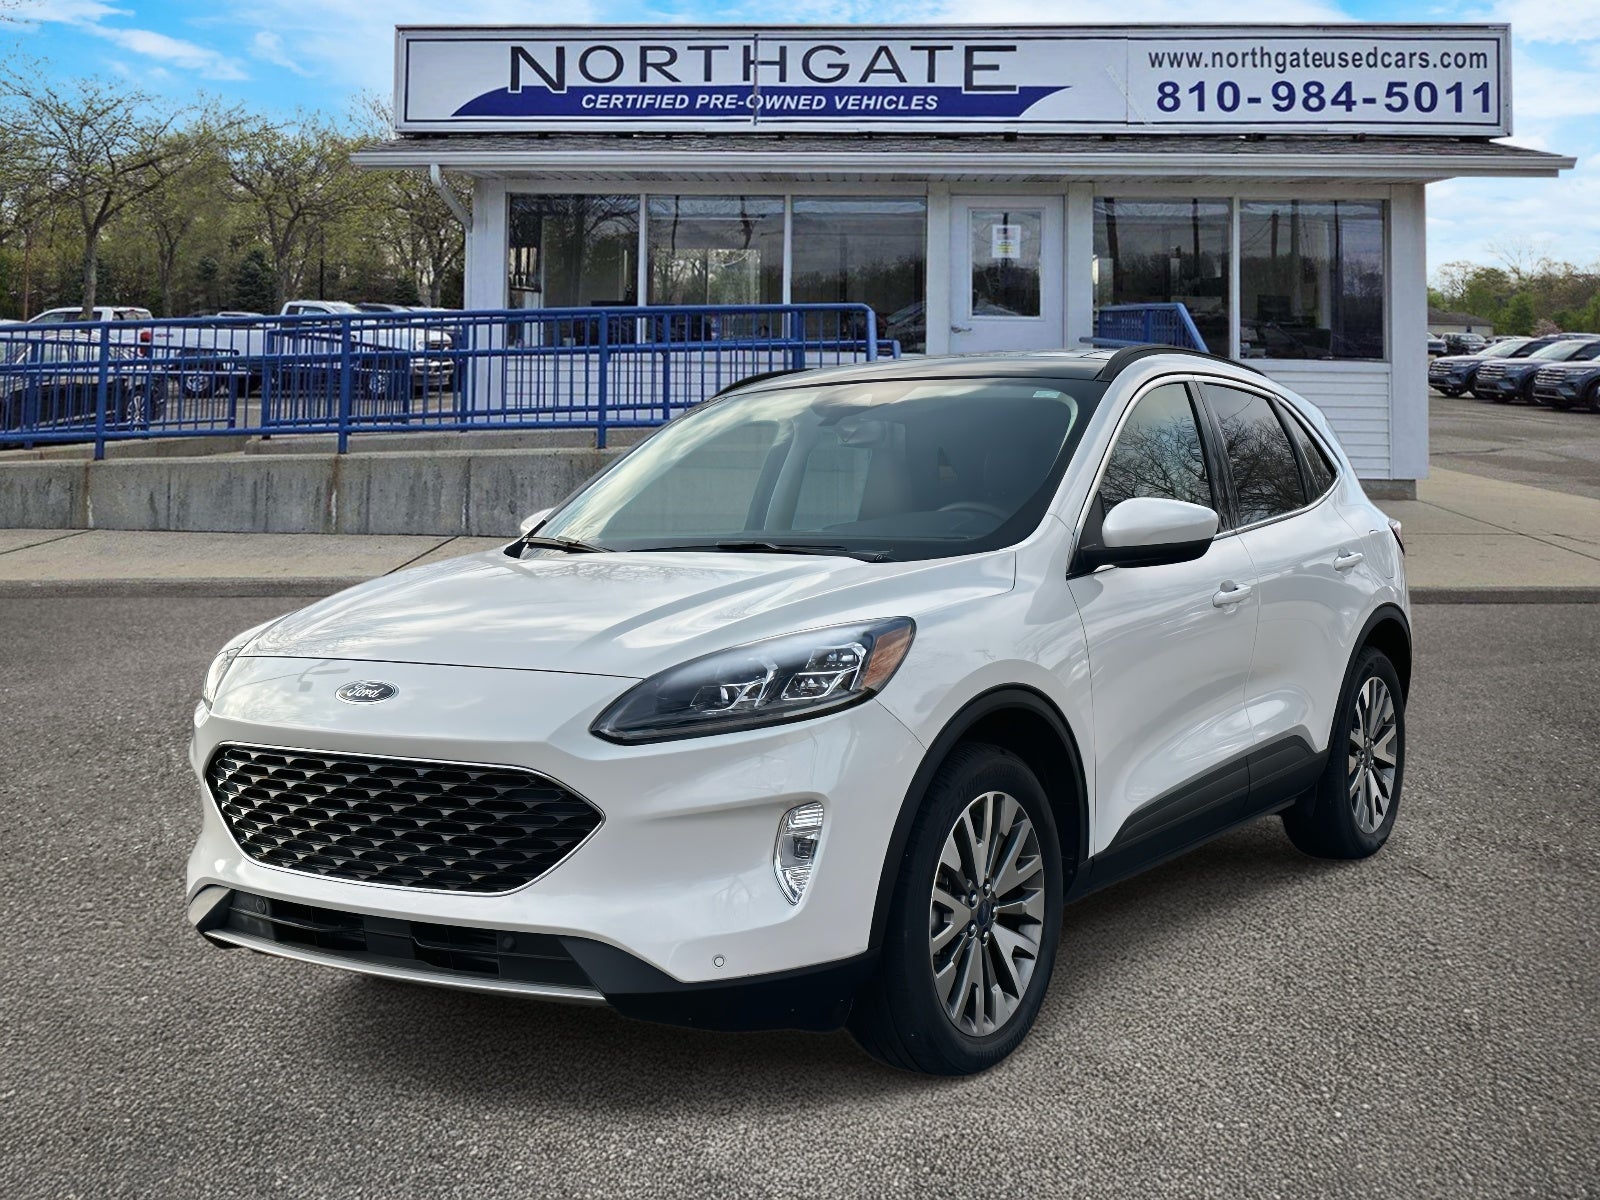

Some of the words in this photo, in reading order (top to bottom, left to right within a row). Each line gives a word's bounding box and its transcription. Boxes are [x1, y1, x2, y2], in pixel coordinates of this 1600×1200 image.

[509, 44, 1018, 93] NORTHGATE
[1148, 46, 1489, 73] www.northgateusedcars.com
[581, 93, 689, 110] CERTIFIED
[695, 93, 827, 111] PRE-OWNED
[834, 94, 939, 111] VEHICLES
[1156, 80, 1491, 114] 810-984-5011
[346, 683, 384, 698] Ford
